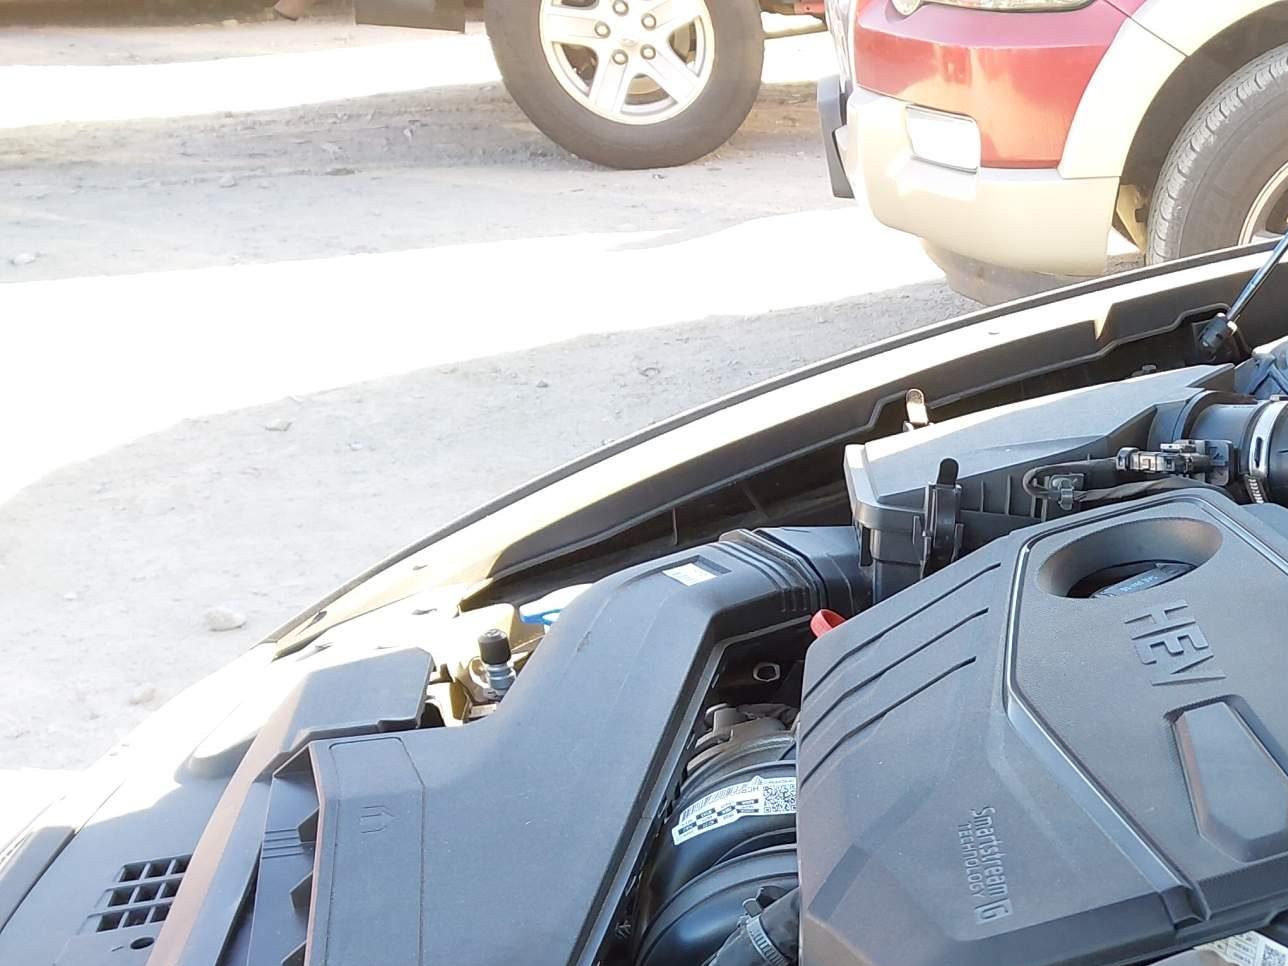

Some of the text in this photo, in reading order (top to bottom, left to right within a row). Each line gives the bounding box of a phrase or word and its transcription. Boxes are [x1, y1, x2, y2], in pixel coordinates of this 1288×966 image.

[1124, 600, 1227, 687] HEV
[958, 821, 986, 898] TECHNOLOGY
[970, 804, 1009, 897] Smartstream
